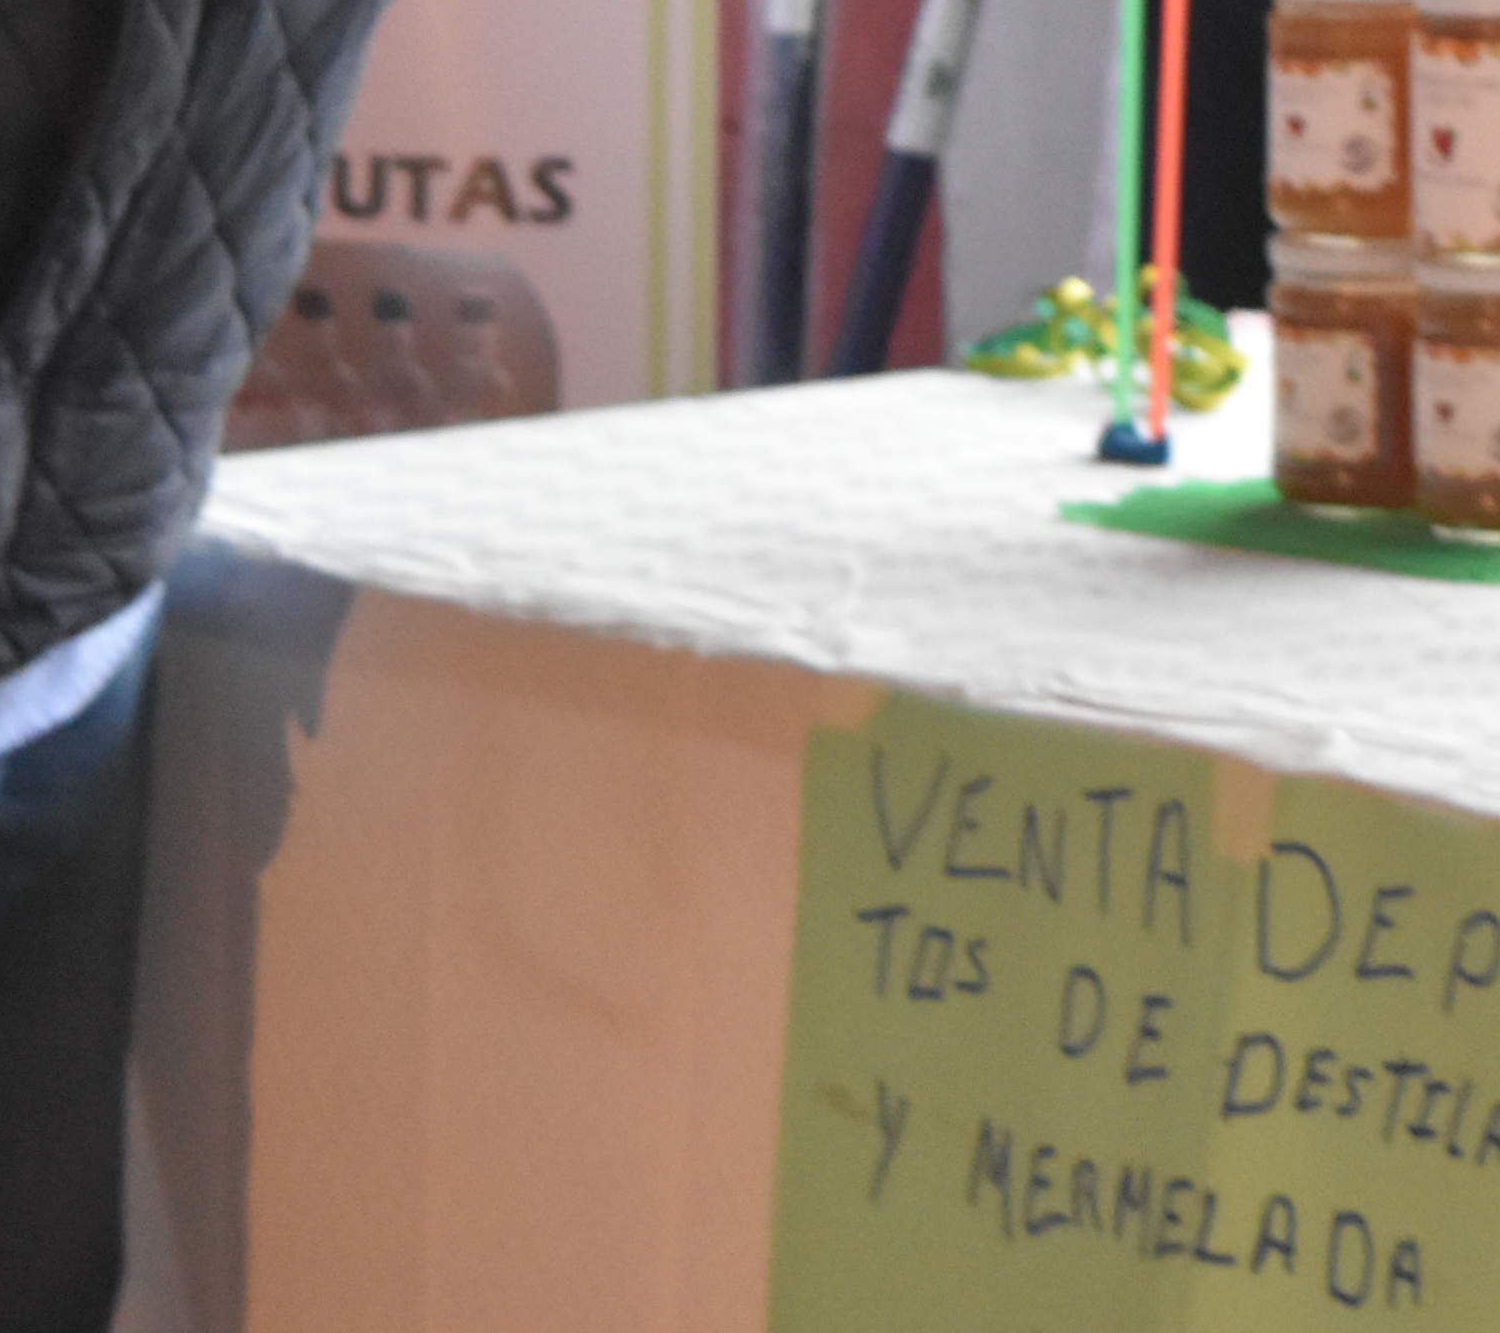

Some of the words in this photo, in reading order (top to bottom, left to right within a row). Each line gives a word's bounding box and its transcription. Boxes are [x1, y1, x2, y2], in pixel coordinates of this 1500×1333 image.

[872, 744, 1195, 944] VENTA
[1255, 839, 1415, 982] DE
[856, 904, 990, 1001] TOS
[1058, 963, 1174, 1085] DE
[869, 1076, 910, 1203] Y
[966, 1117, 1424, 1309] MERMELADA
